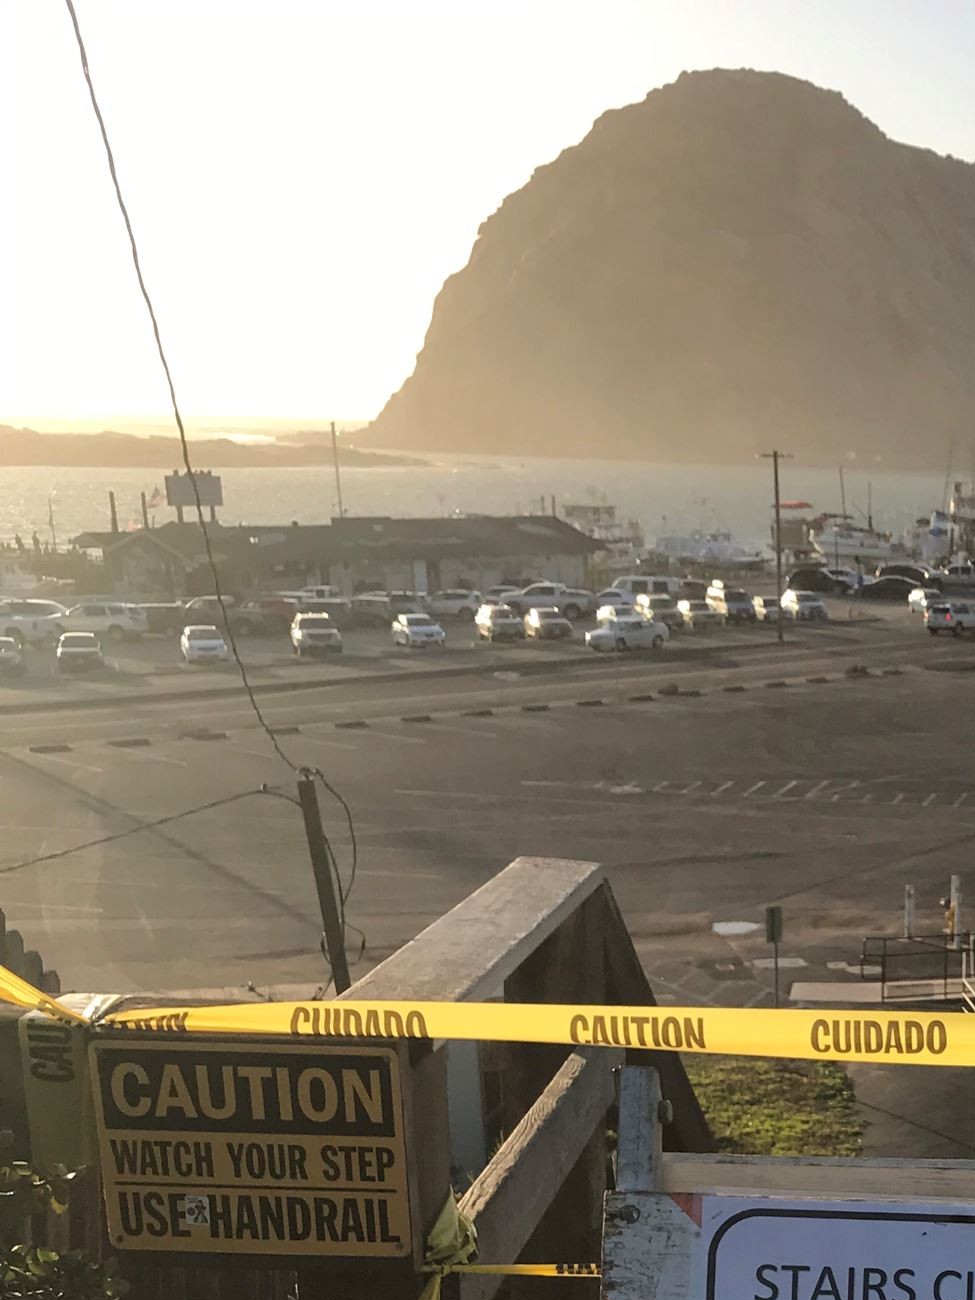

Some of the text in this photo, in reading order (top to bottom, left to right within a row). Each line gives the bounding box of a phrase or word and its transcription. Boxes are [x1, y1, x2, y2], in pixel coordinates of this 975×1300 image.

[290, 1007, 429, 1039] CUIDADO
[569, 1014, 707, 1050] CAUTION
[810, 1018, 948, 1055] CUIDADO
[110, 1062, 384, 1124] CAUTION
[110, 1139, 395, 1183] WATCH YOUR STEP
[118, 1191, 401, 1243] USE HANDRAIL
